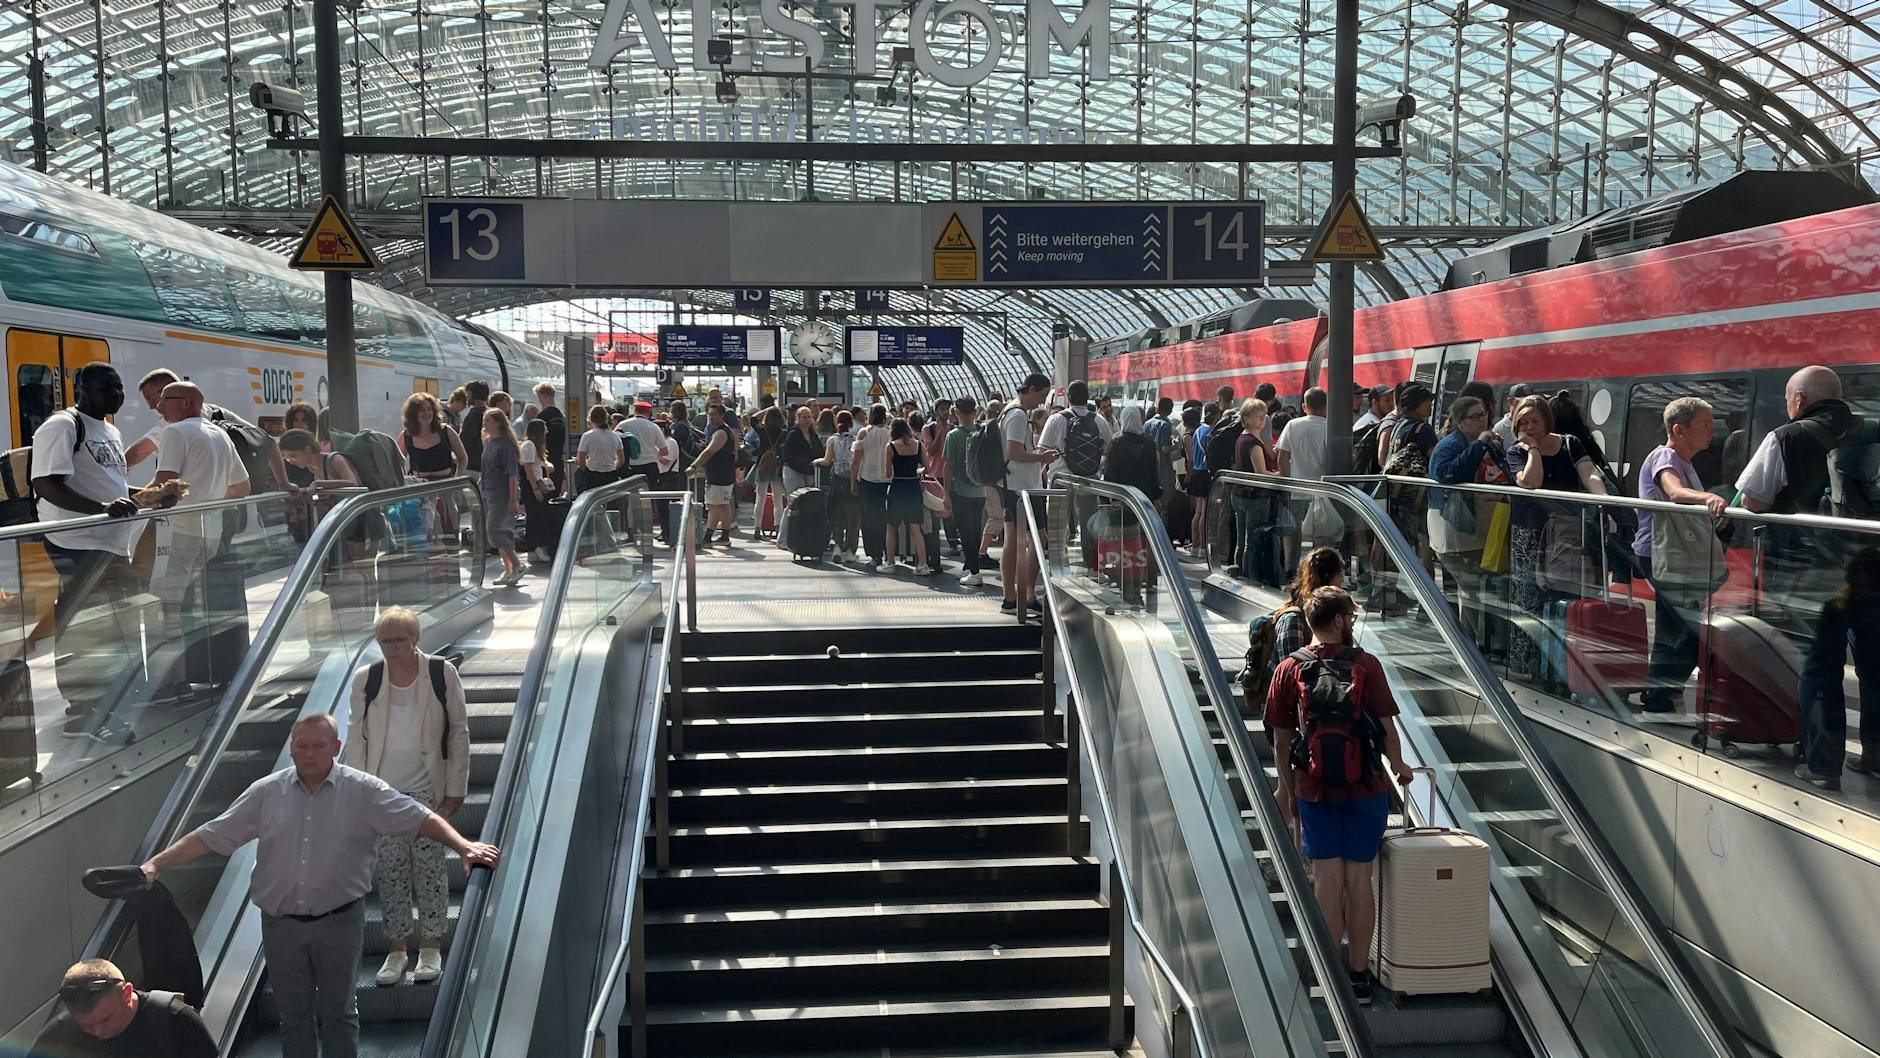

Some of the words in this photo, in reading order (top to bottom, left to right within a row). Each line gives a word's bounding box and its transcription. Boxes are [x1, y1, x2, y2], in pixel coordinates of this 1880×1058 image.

[587, 0, 1110, 87] ALSTOM
[439, 207, 500, 261] 13
[1016, 232, 1049, 246] Bitte
[1052, 232, 1135, 249] weitergehen
[1193, 210, 1250, 261] 14
[1017, 250, 1044, 263] Keep
[1046, 251, 1084, 263] moving
[263, 368, 293, 405] ODEG
[657, 369, 667, 382] D
